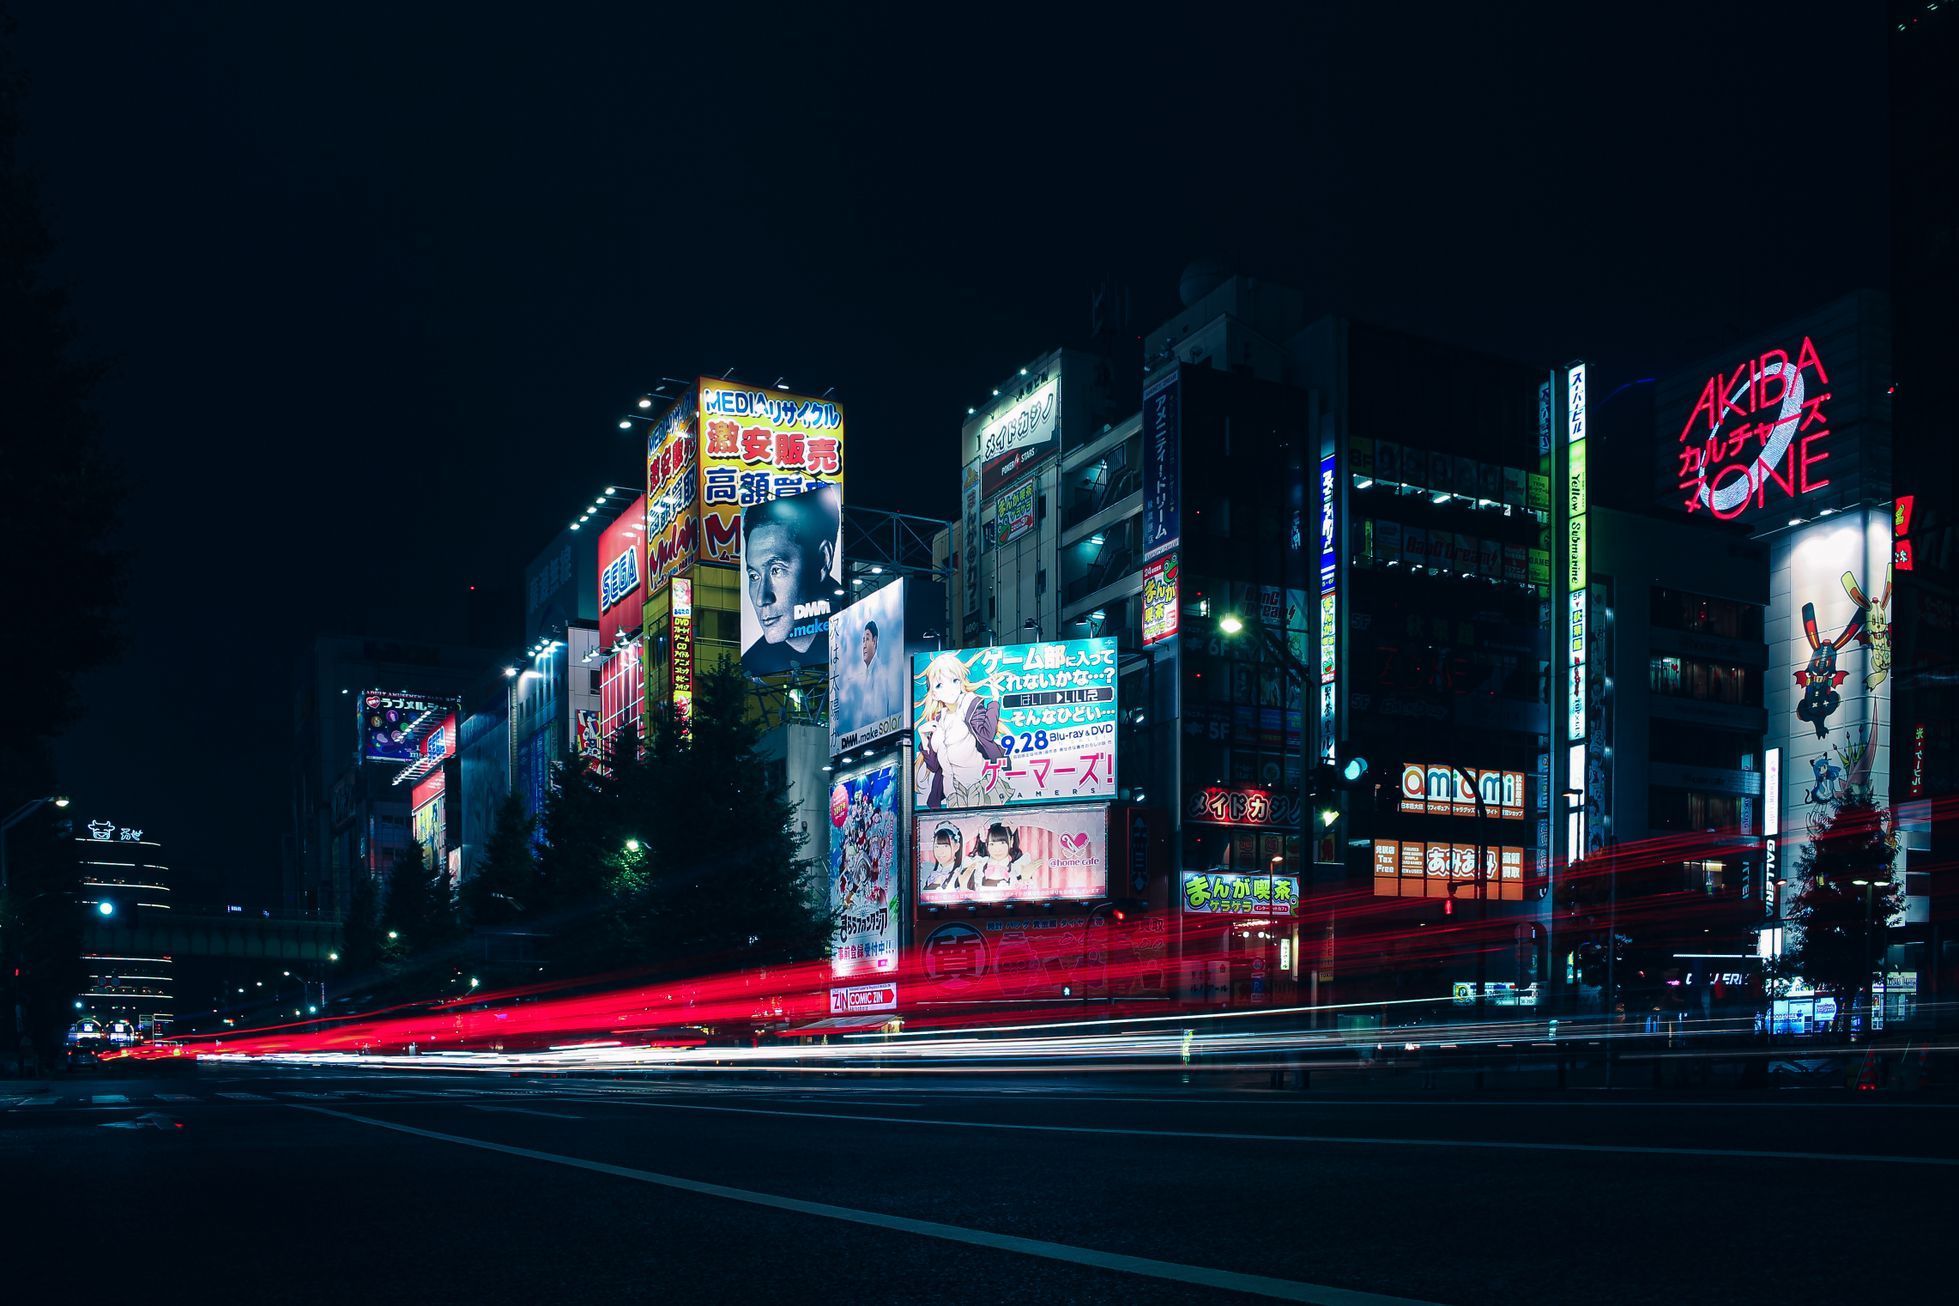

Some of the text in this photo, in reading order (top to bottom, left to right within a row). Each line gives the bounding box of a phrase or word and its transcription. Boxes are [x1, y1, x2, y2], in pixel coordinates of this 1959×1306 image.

[1571, 371, 1583, 435] スーパービル
[1679, 336, 1829, 442] AKIBA
[704, 388, 840, 430] MEDIAリサイクル
[985, 393, 1054, 460] メイドカジノ
[1679, 393, 1832, 478] カルチャーズ
[707, 419, 840, 475] 激安販売
[1154, 393, 1170, 541] アメニティードリーム
[1571, 472, 1581, 513] Yellow
[1571, 521, 1581, 585] Submarine
[601, 545, 640, 613] SEGA
[1145, 579, 1176, 606] まんが
[673, 634, 690, 643] ゲーム
[674, 618, 690, 627] DVD
[673, 658, 690, 667] アニメ
[676, 642, 688, 651] CD
[981, 643, 1115, 675] ゲーム部に入って
[1019, 688, 1100, 706] はい いいえ
[1001, 730, 1049, 756] 9.28
[1049, 730, 1085, 743] Blu-ray
[1091, 724, 1114, 737] DVD
[981, 752, 1114, 793] ゲーマーズ!
[1049, 857, 1100, 869] @home cafe
[1376, 864, 1395, 873] Free
[1377, 855, 1393, 864] Tax
[1185, 876, 1292, 907] まんが喫茶
[1765, 839, 1776, 918] GALLERIA
[840, 907, 888, 944] きららファンタジア
[850, 990, 883, 1005] COMIC ZIN
